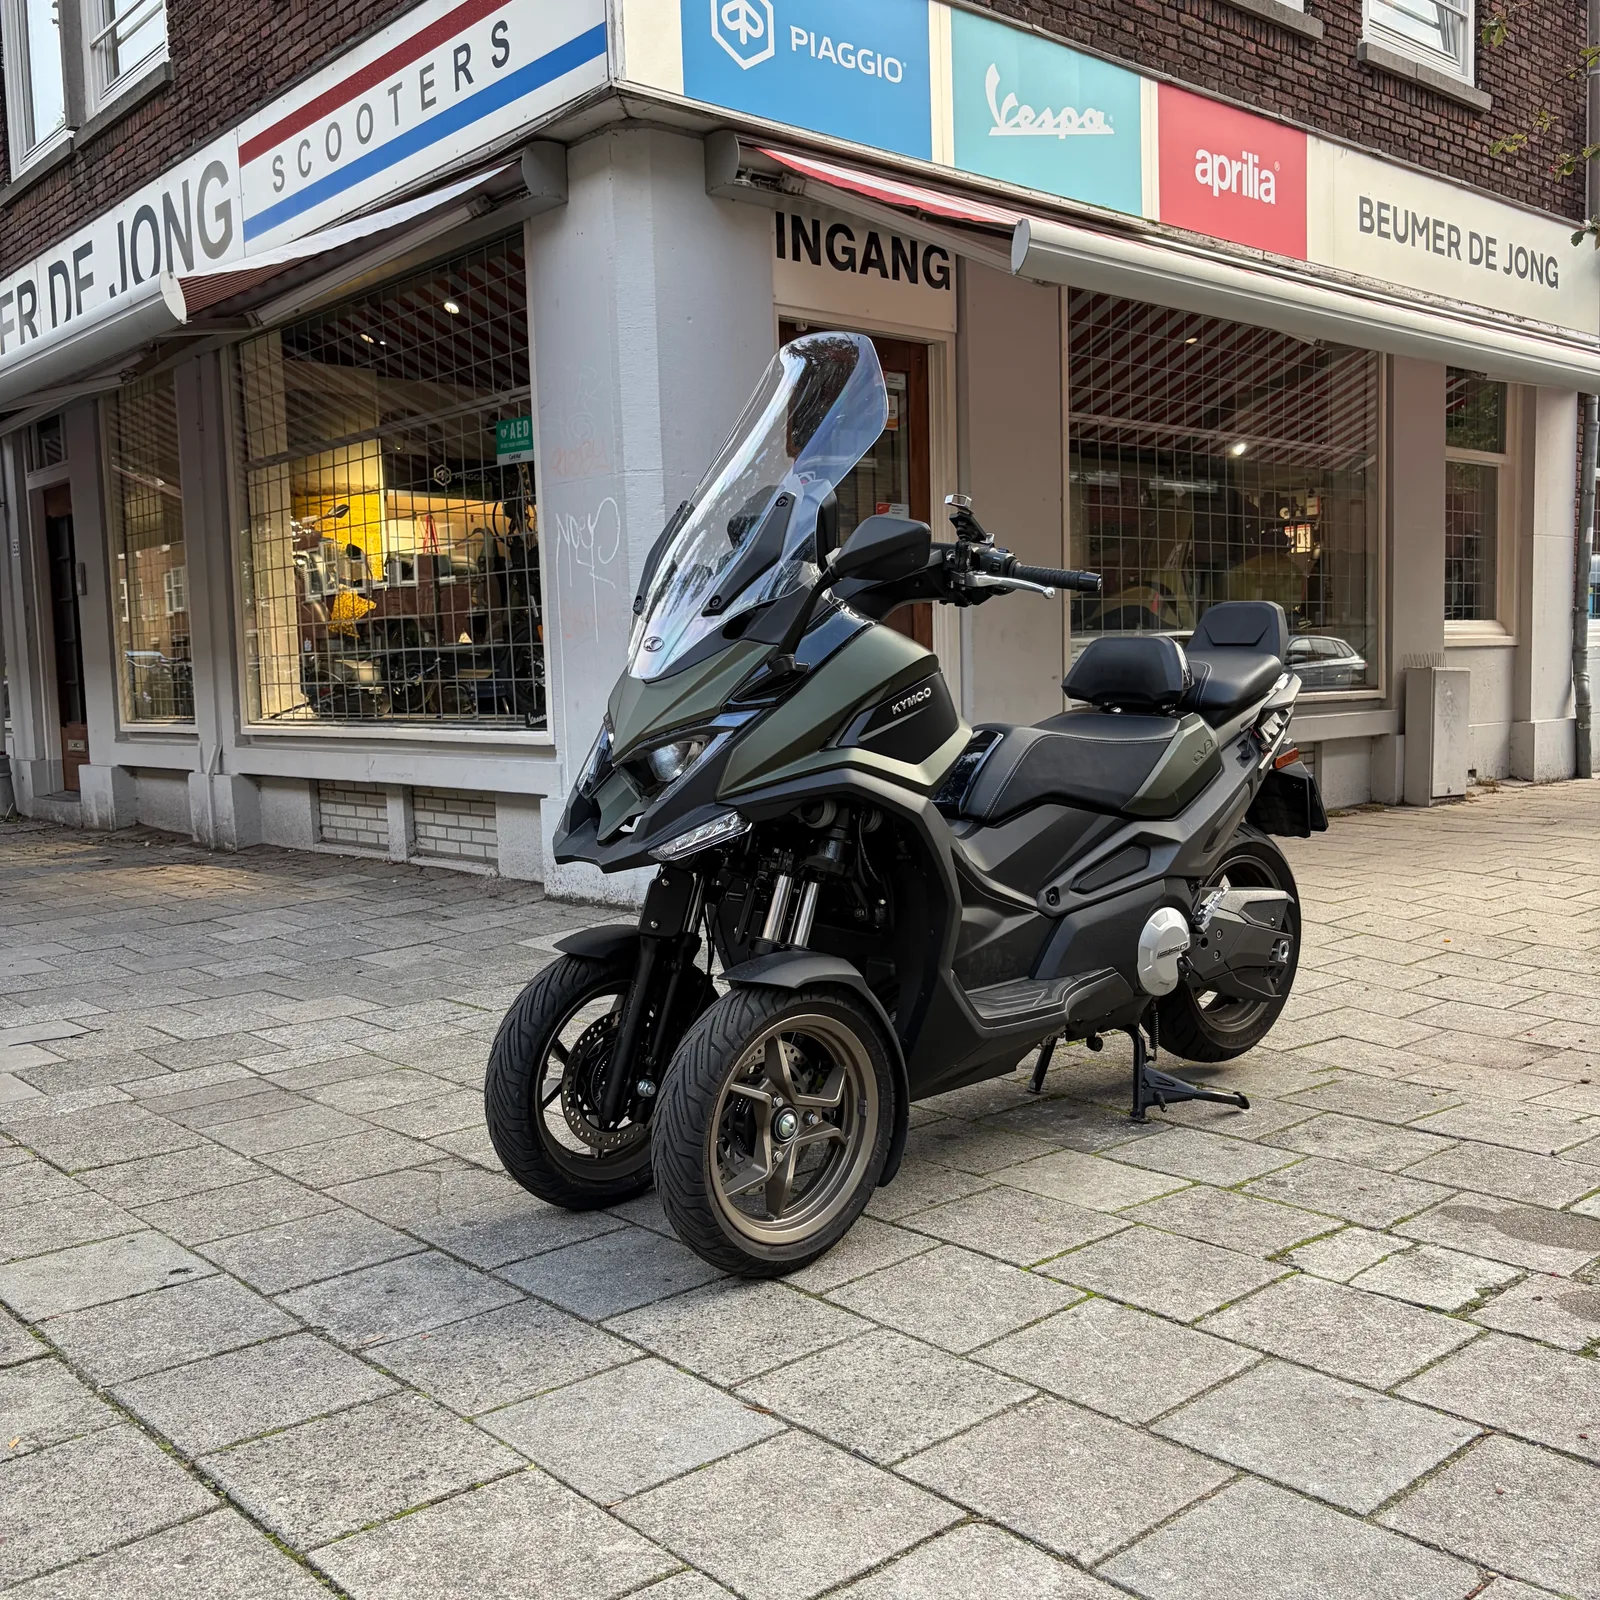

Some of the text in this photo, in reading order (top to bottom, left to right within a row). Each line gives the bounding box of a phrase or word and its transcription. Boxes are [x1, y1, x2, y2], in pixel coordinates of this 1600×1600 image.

[789, 25, 904, 84] PIAGGIO
[272, 19, 511, 193] SCOOTERS
[985, 62, 1115, 140] Vespa
[1194, 148, 1276, 205] aprilia
[109, 159, 234, 300] JONG
[775, 210, 951, 291] INGANG
[1358, 195, 1560, 290] BEUMER DE JONG
[509, 419, 530, 440] AED
[891, 686, 932, 715] KYMCO
